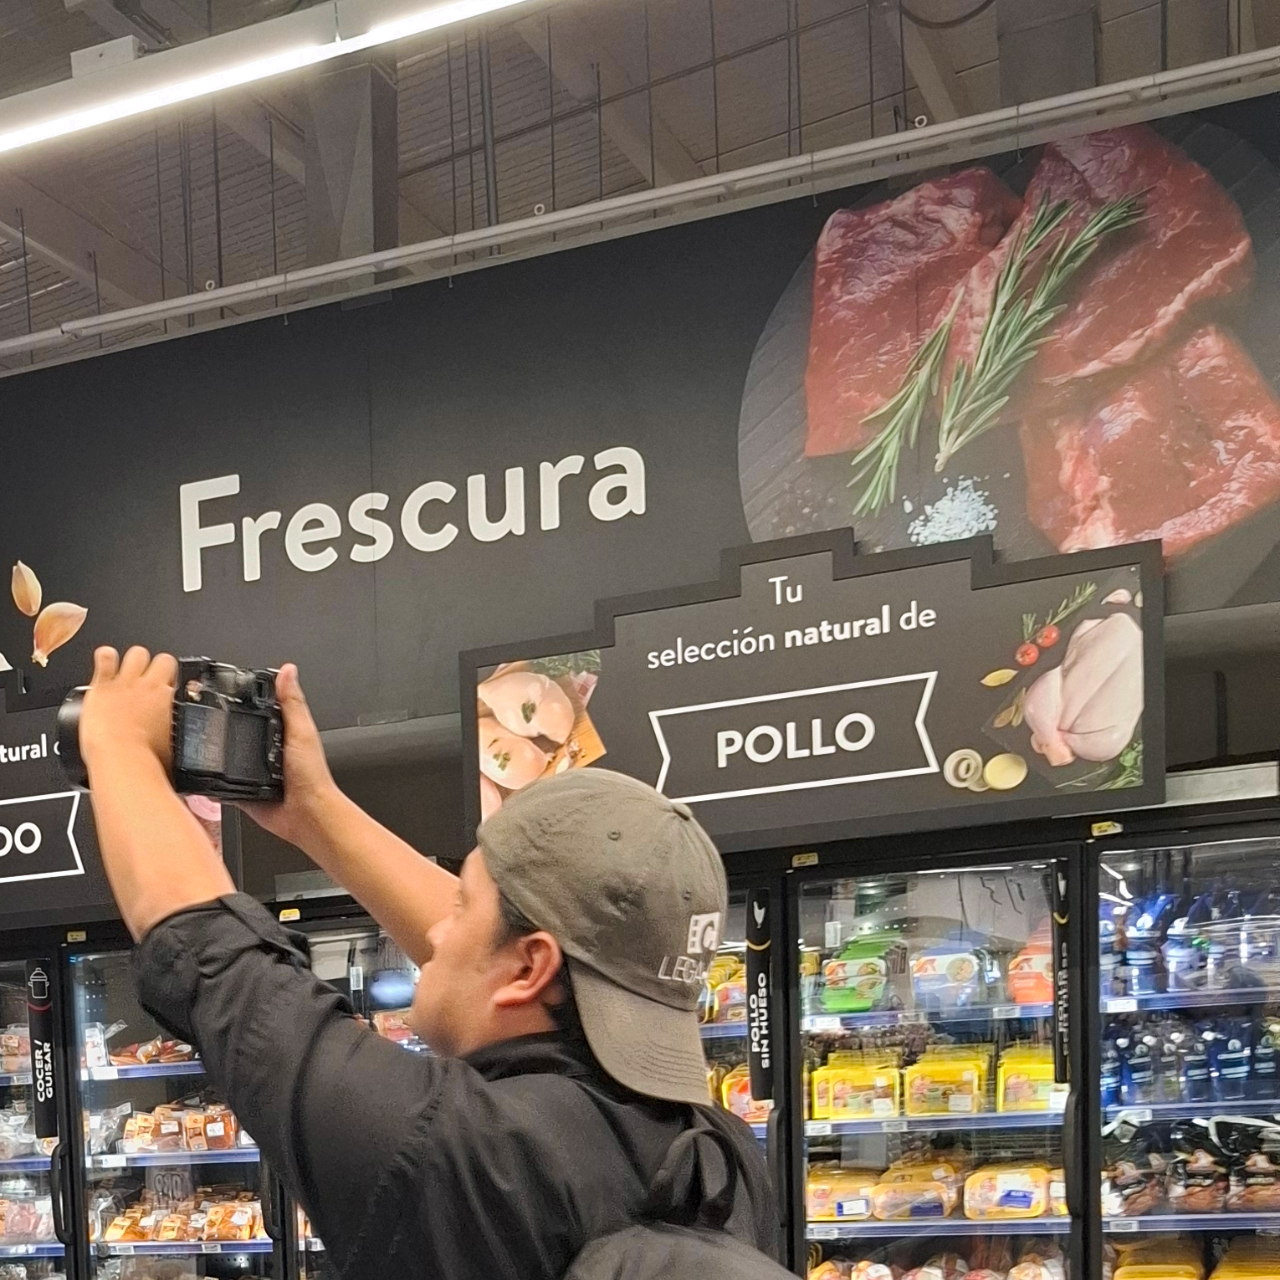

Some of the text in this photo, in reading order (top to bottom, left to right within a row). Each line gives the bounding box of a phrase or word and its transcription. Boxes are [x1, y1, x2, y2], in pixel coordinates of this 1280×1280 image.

[179, 445, 646, 593] Frescura
[768, 575, 803, 606] Tu
[647, 600, 937, 669] selección natural de
[716, 712, 876, 768] POLLO
[750, 993, 760, 1053] POLLO
[758, 972, 770, 1069] SIN HUESO
[34, 1049, 46, 1102] COCER
[43, 1042, 54, 1099] GUISAR
